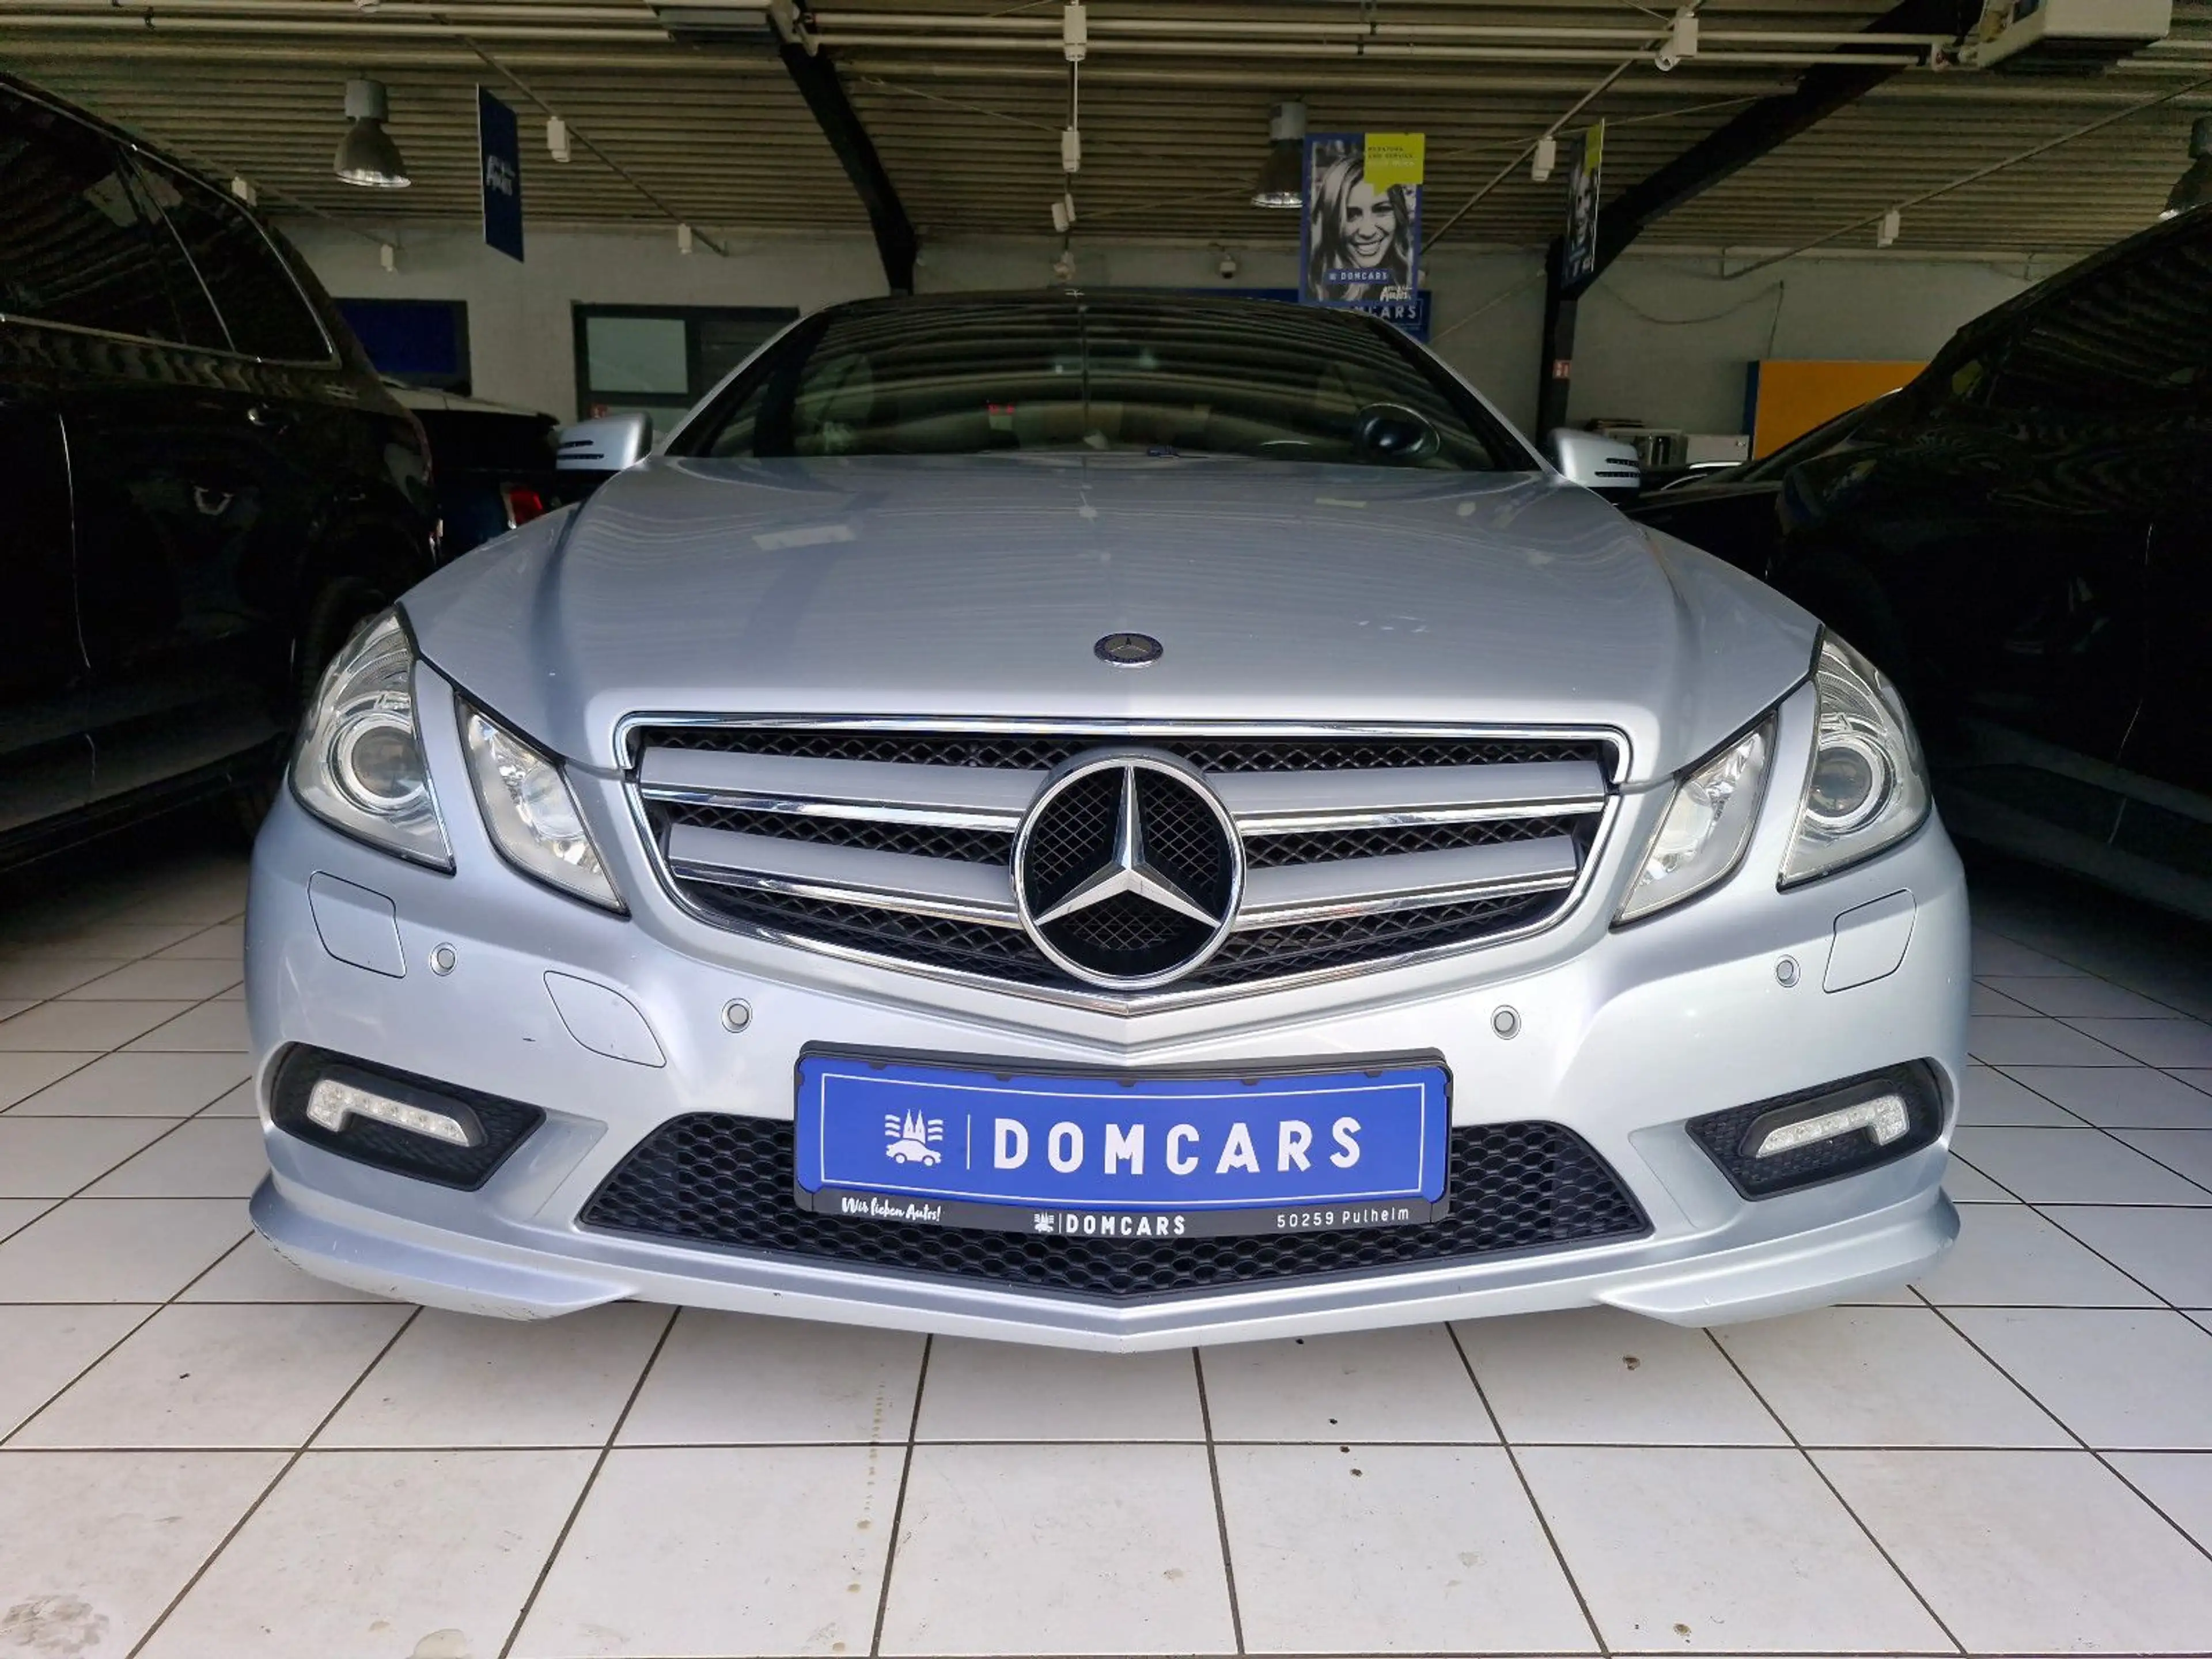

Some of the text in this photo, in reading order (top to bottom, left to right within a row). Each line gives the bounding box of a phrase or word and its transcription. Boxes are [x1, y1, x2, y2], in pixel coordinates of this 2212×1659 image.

[1340, 272, 1387, 281] DOMCARS
[994, 1117, 1361, 1175] DOMCARS
[842, 1196, 941, 1222] Wir lieben Autos!
[1277, 1207, 1410, 1228] 50259 Pulheim
[1066, 1213, 1185, 1236] DOMCARS
